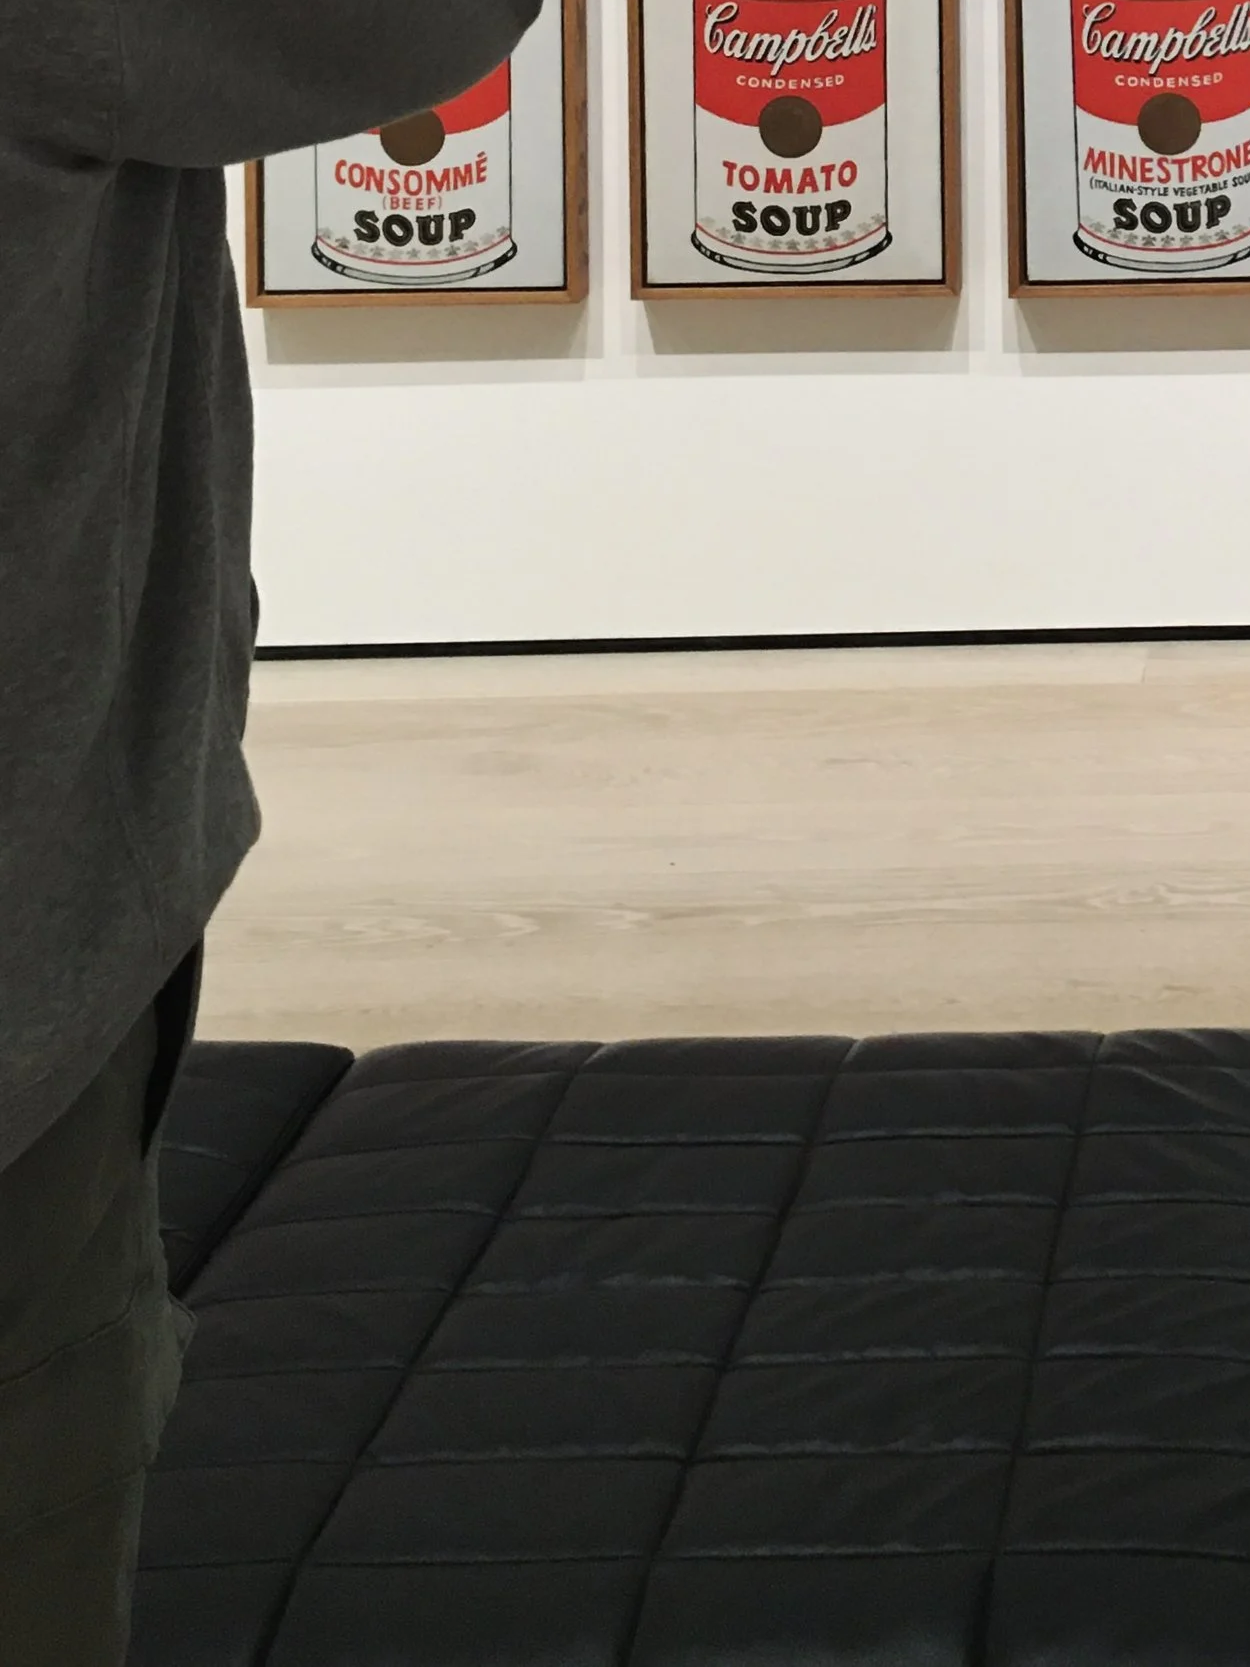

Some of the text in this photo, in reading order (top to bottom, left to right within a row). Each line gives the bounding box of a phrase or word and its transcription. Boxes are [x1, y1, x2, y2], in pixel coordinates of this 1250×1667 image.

[737, 75, 843, 89] CONDENSED
[1115, 73, 1222, 88] CONDENSED
[335, 151, 488, 196] CONSOMMÉ
[724, 159, 857, 194] TOMATO
[1090, 176, 1169, 196] (ITALIAN-STYLE
[1173, 179, 1228, 197] VEGETABLE
[383, 196, 442, 210] (BEEF)
[732, 200, 851, 236] SOUP
[1113, 195, 1231, 233] SOUP
[354, 206, 476, 247] SOUP
